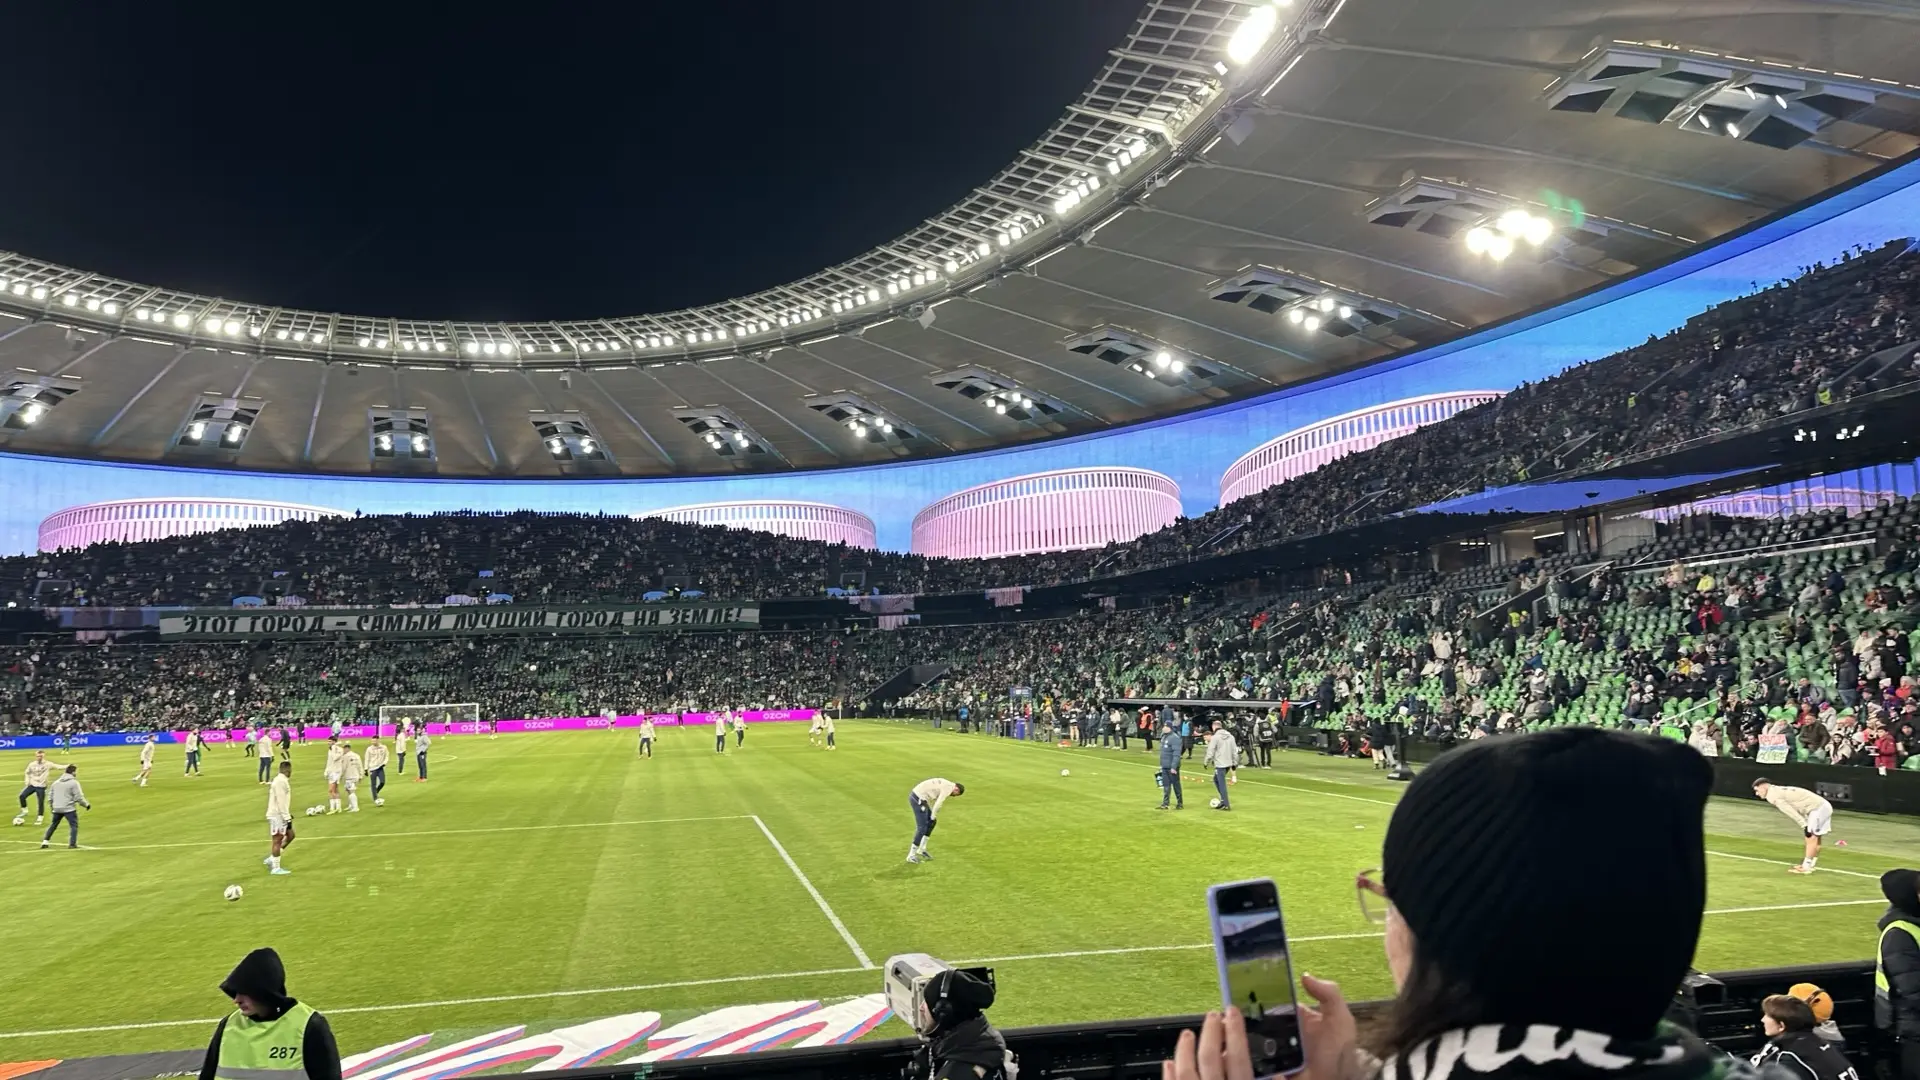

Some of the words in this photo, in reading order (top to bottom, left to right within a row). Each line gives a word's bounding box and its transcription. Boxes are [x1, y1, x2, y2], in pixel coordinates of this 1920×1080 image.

[183, 615, 239, 634] ЭТОТ
[249, 614, 325, 635] ГОРОД
[356, 611, 442, 632] САМЫЙ
[452, 609, 548, 631] ЛУЧШИЙ
[555, 610, 625, 629] ГОРОД
[633, 609, 661, 627] НА
[669, 607, 743, 626] ЗЕМЛЕ!
[763, 712, 791, 720] OZON
[524, 721, 555, 729] OZON
[340, 728, 363, 736] ZON
[53, 736, 89, 746] OON
[268, 1046, 298, 1060] 287
